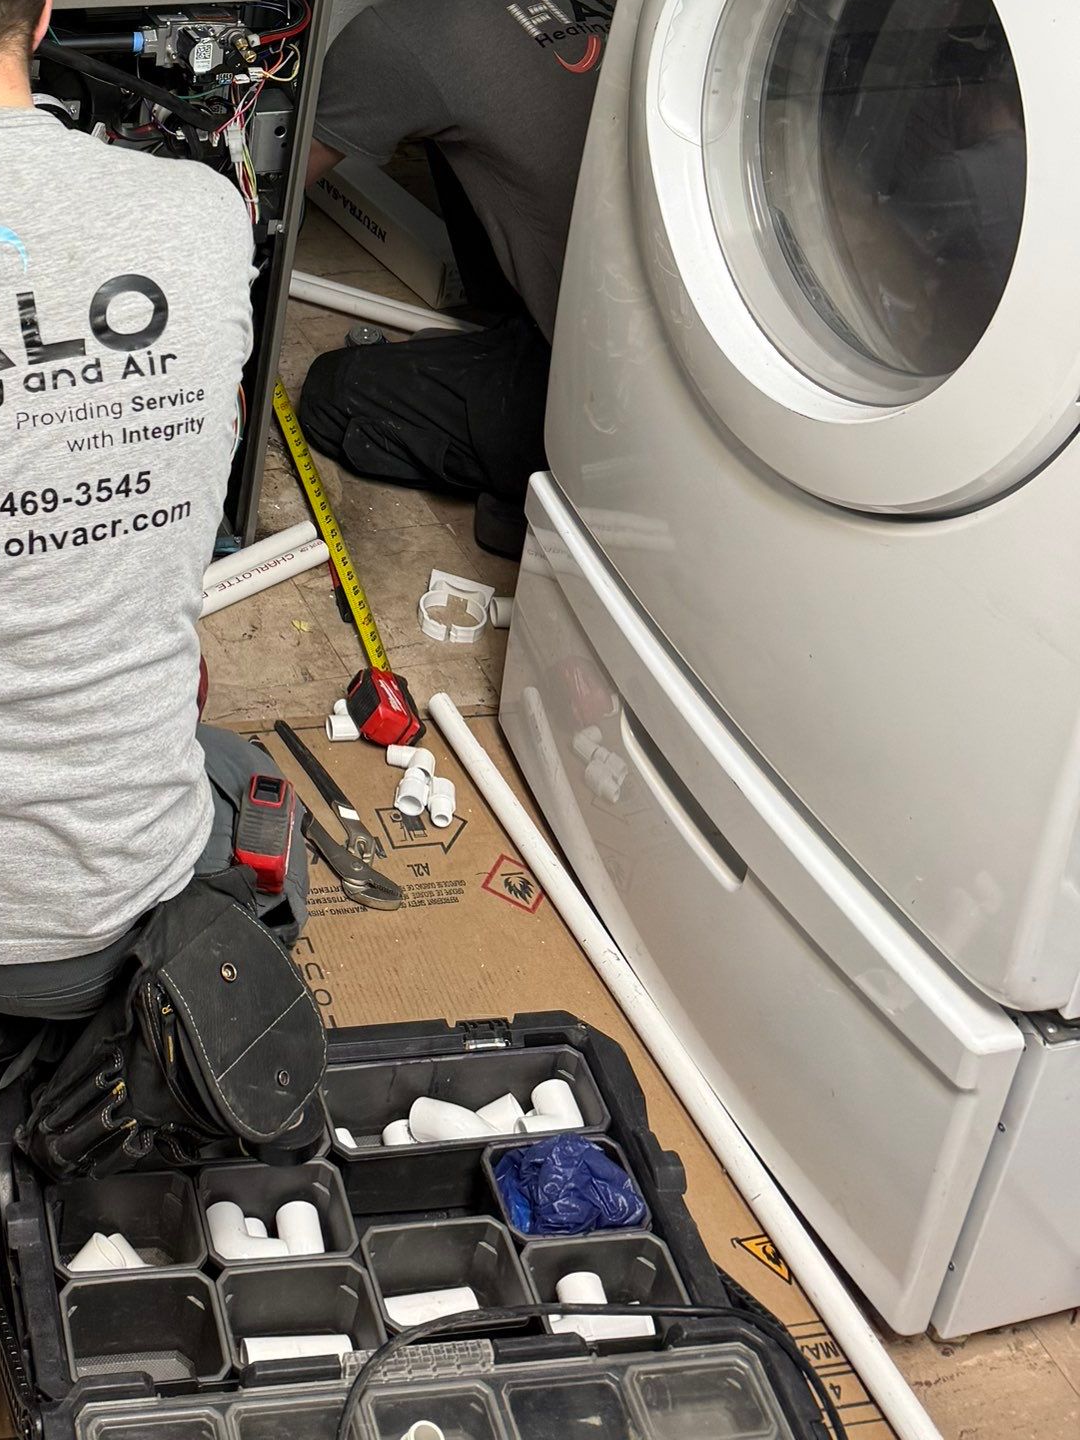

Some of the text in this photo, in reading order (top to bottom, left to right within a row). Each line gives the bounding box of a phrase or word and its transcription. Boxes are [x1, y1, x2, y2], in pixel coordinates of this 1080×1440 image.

[23, 357, 103, 393] and
[122, 350, 178, 380] Air
[16, 386, 205, 430] Providing Service
[67, 416, 205, 452] with Integrity
[0, 470, 151, 517] 469-3545
[215, 553, 295, 592] CHARLOTTE
[407, 862, 430, 877] A2L
[329, 906, 368, 916] WARNING
